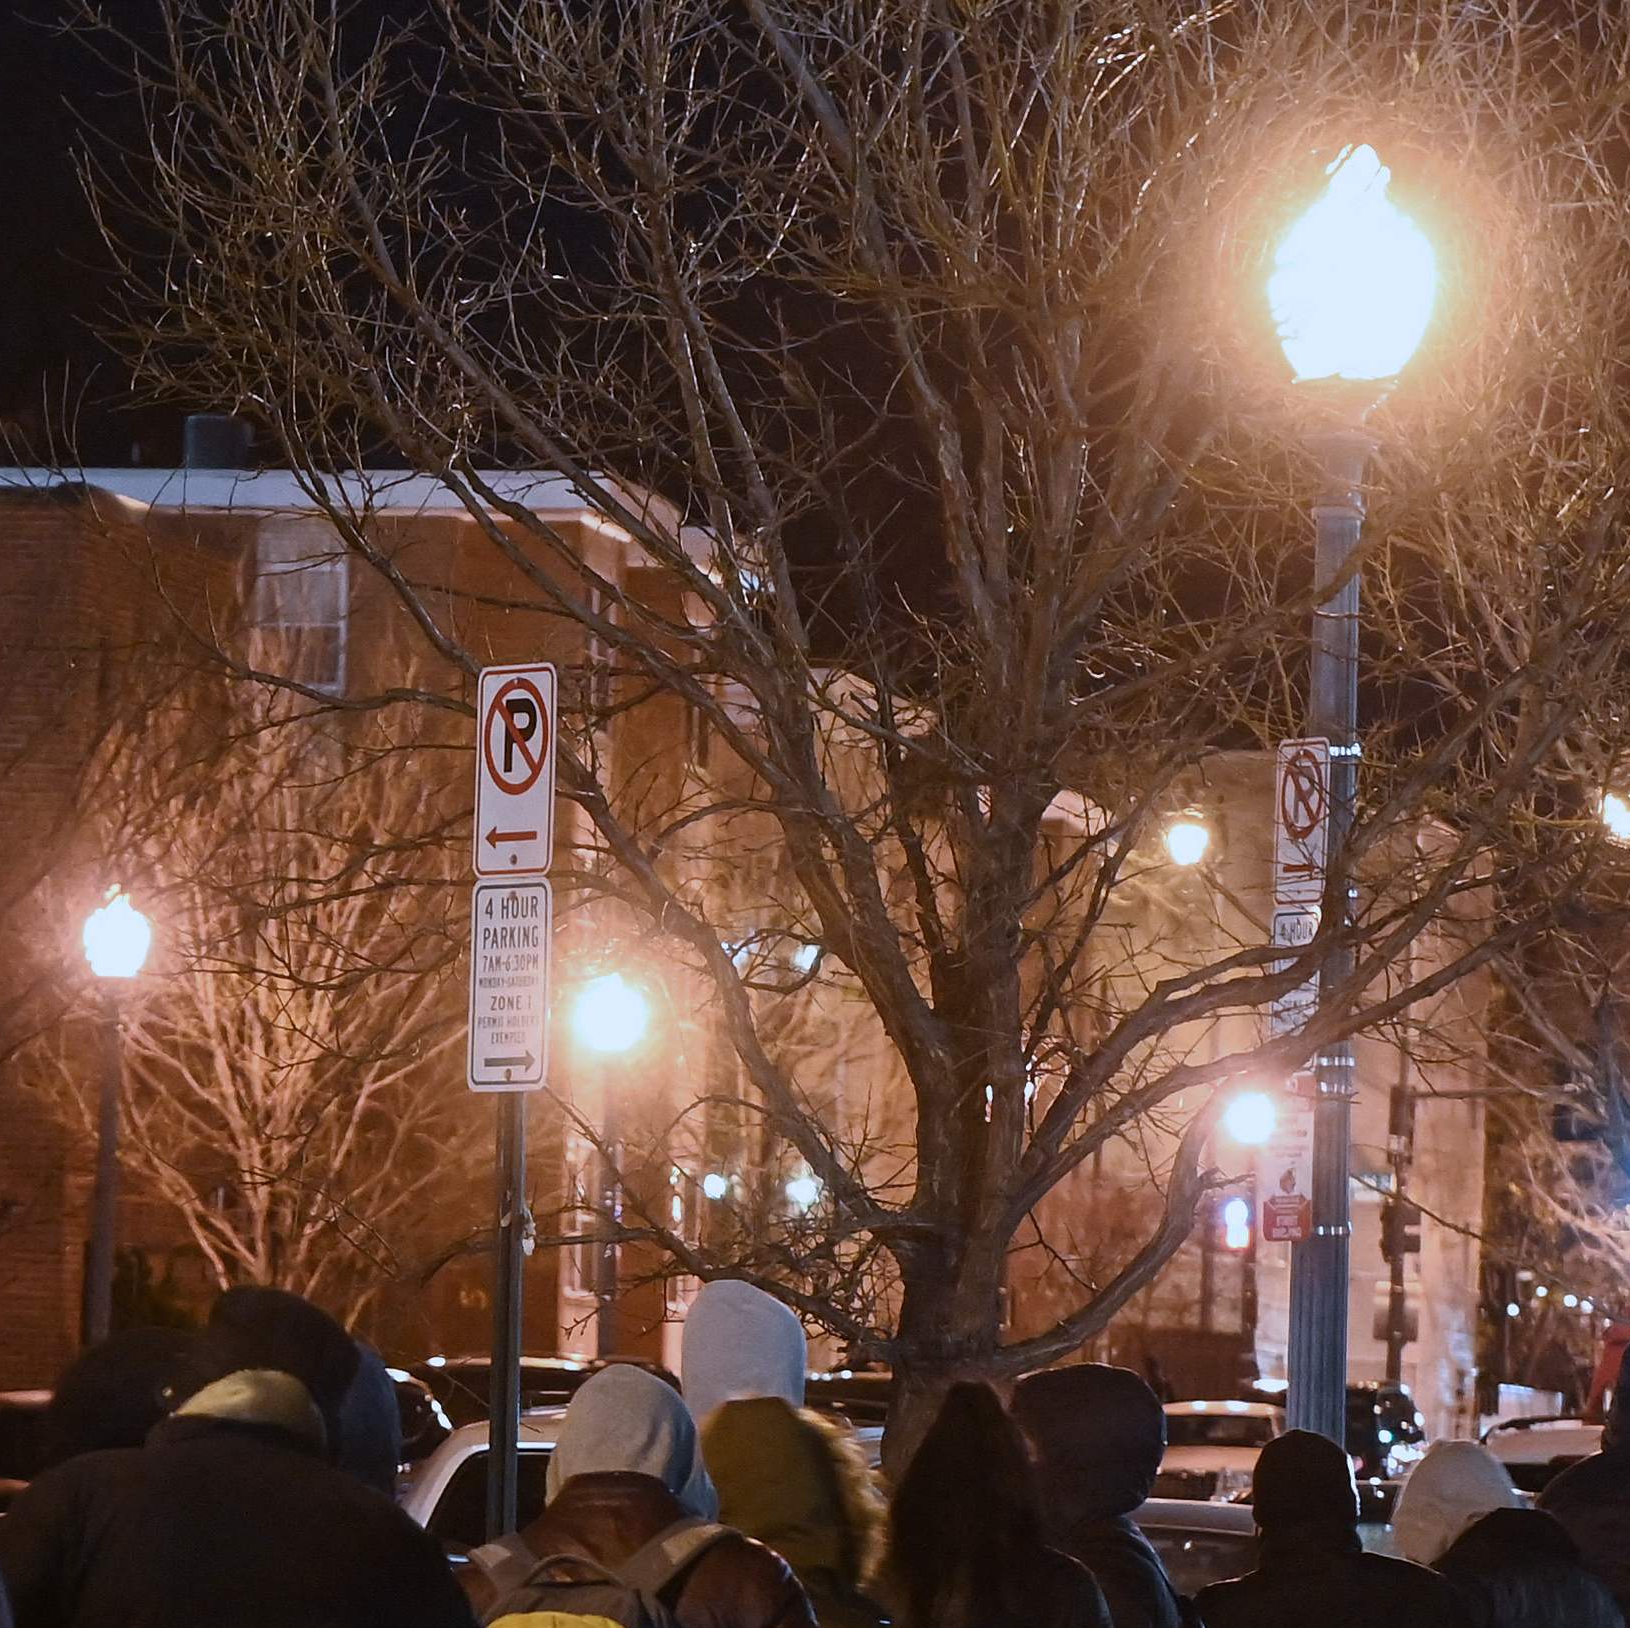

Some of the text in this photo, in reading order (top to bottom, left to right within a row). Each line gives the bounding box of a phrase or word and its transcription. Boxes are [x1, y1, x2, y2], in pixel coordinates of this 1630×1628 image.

[485, 895, 539, 920] 4 HOUR
[482, 925, 539, 950] PARKING
[1290, 920, 1314, 940] HOUR
[490, 995, 521, 1011] ZONE
